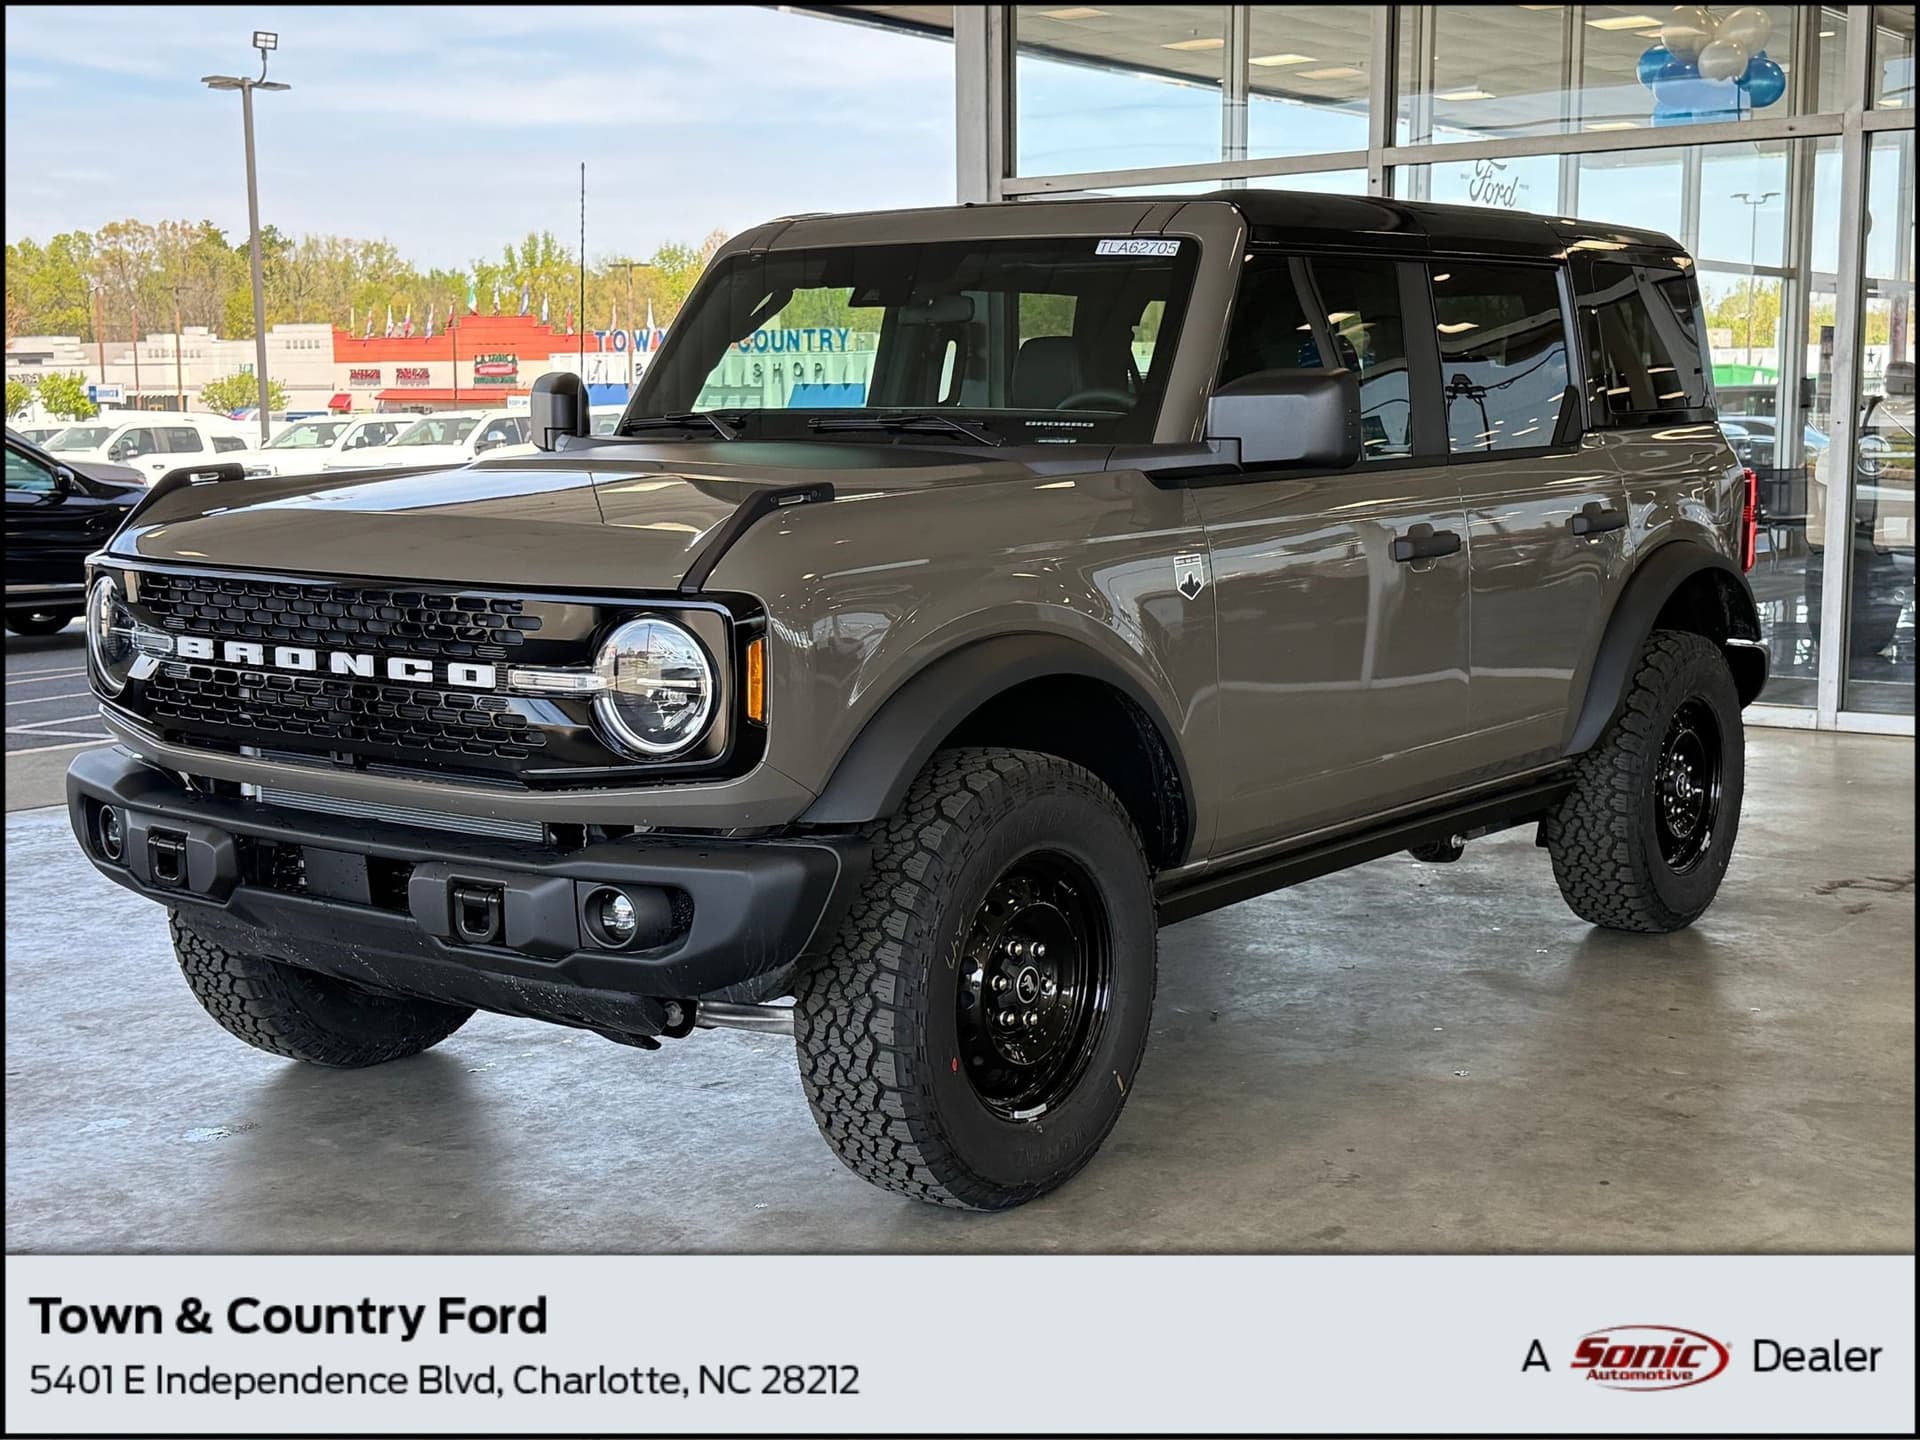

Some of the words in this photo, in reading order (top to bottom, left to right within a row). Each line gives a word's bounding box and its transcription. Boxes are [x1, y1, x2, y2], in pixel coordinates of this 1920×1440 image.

[1469, 158, 1519, 208] Ford
[1100, 241, 1177, 255] TLA62705
[753, 361, 824, 379] SHOP
[177, 634, 497, 690] BRONCO
